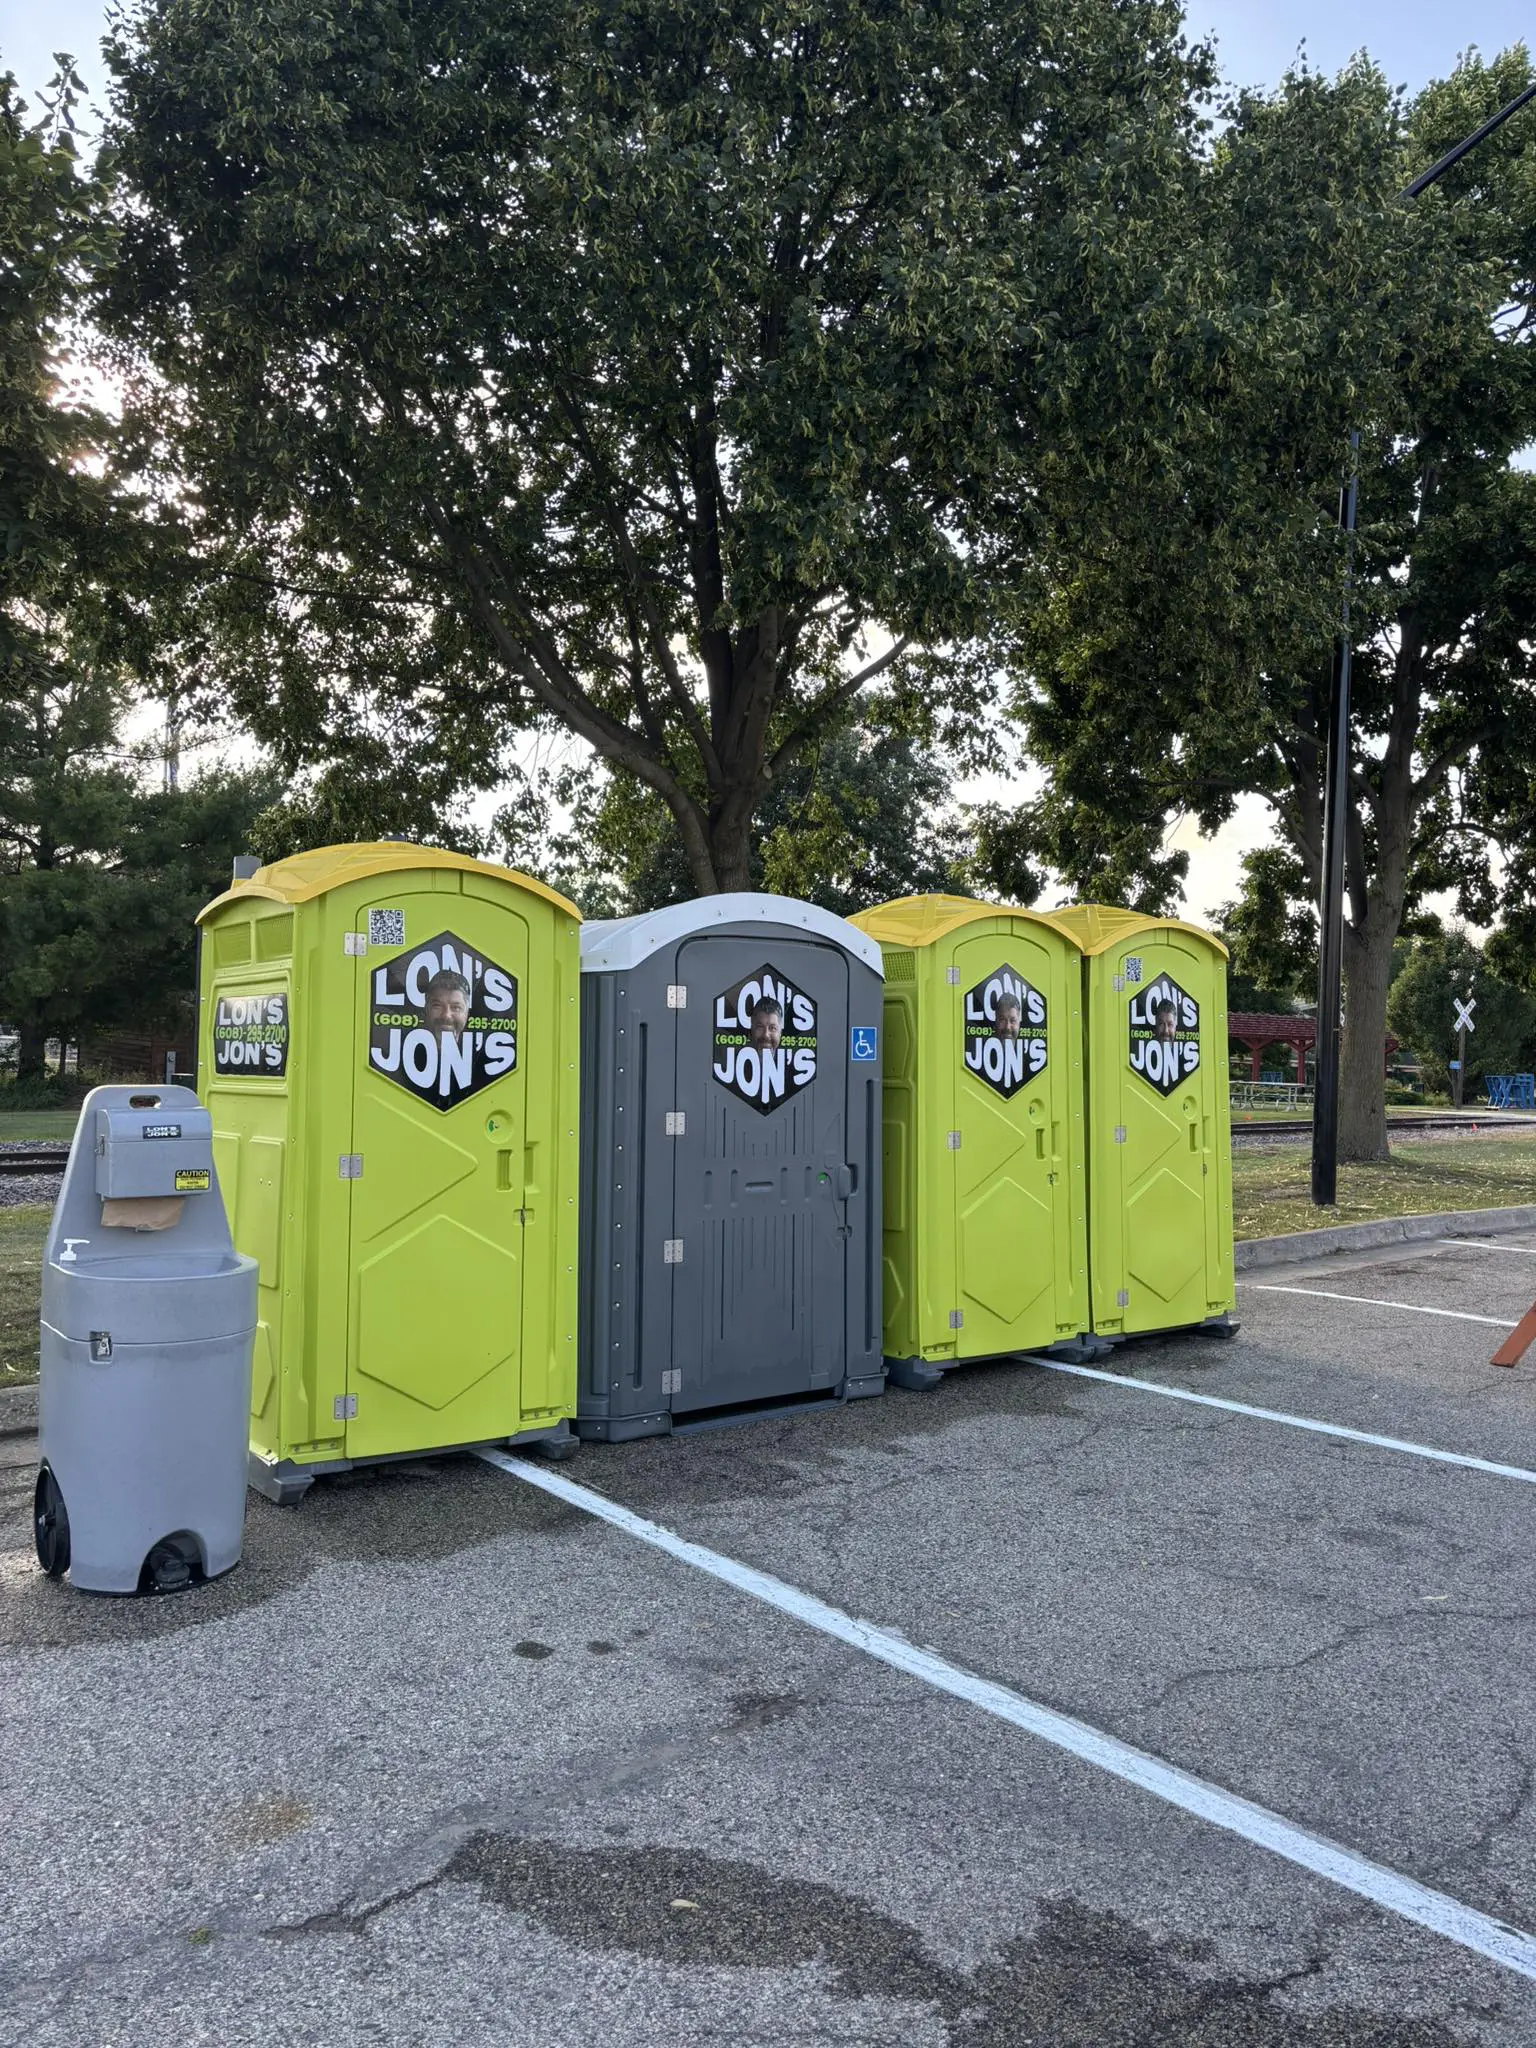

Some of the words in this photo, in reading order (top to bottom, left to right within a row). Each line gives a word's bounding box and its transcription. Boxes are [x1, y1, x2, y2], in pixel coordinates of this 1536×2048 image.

[375, 943, 514, 1012] LON'S
[966, 972, 1046, 1024] LON'S
[218, 998, 284, 1026] LON'S
[467, 1016, 517, 1030] 295-2700
[716, 974, 815, 1031] LON'S
[217, 1040, 282, 1067] JON'S
[370, 1028, 516, 1097] JON'S
[781, 1036, 817, 1047] 295-2700
[965, 1037, 1047, 1088] JON'S
[1130, 1040, 1200, 1087] JON'S
[713, 1047, 816, 1104] JON'S
[176, 1170, 209, 1178] CAUTION
